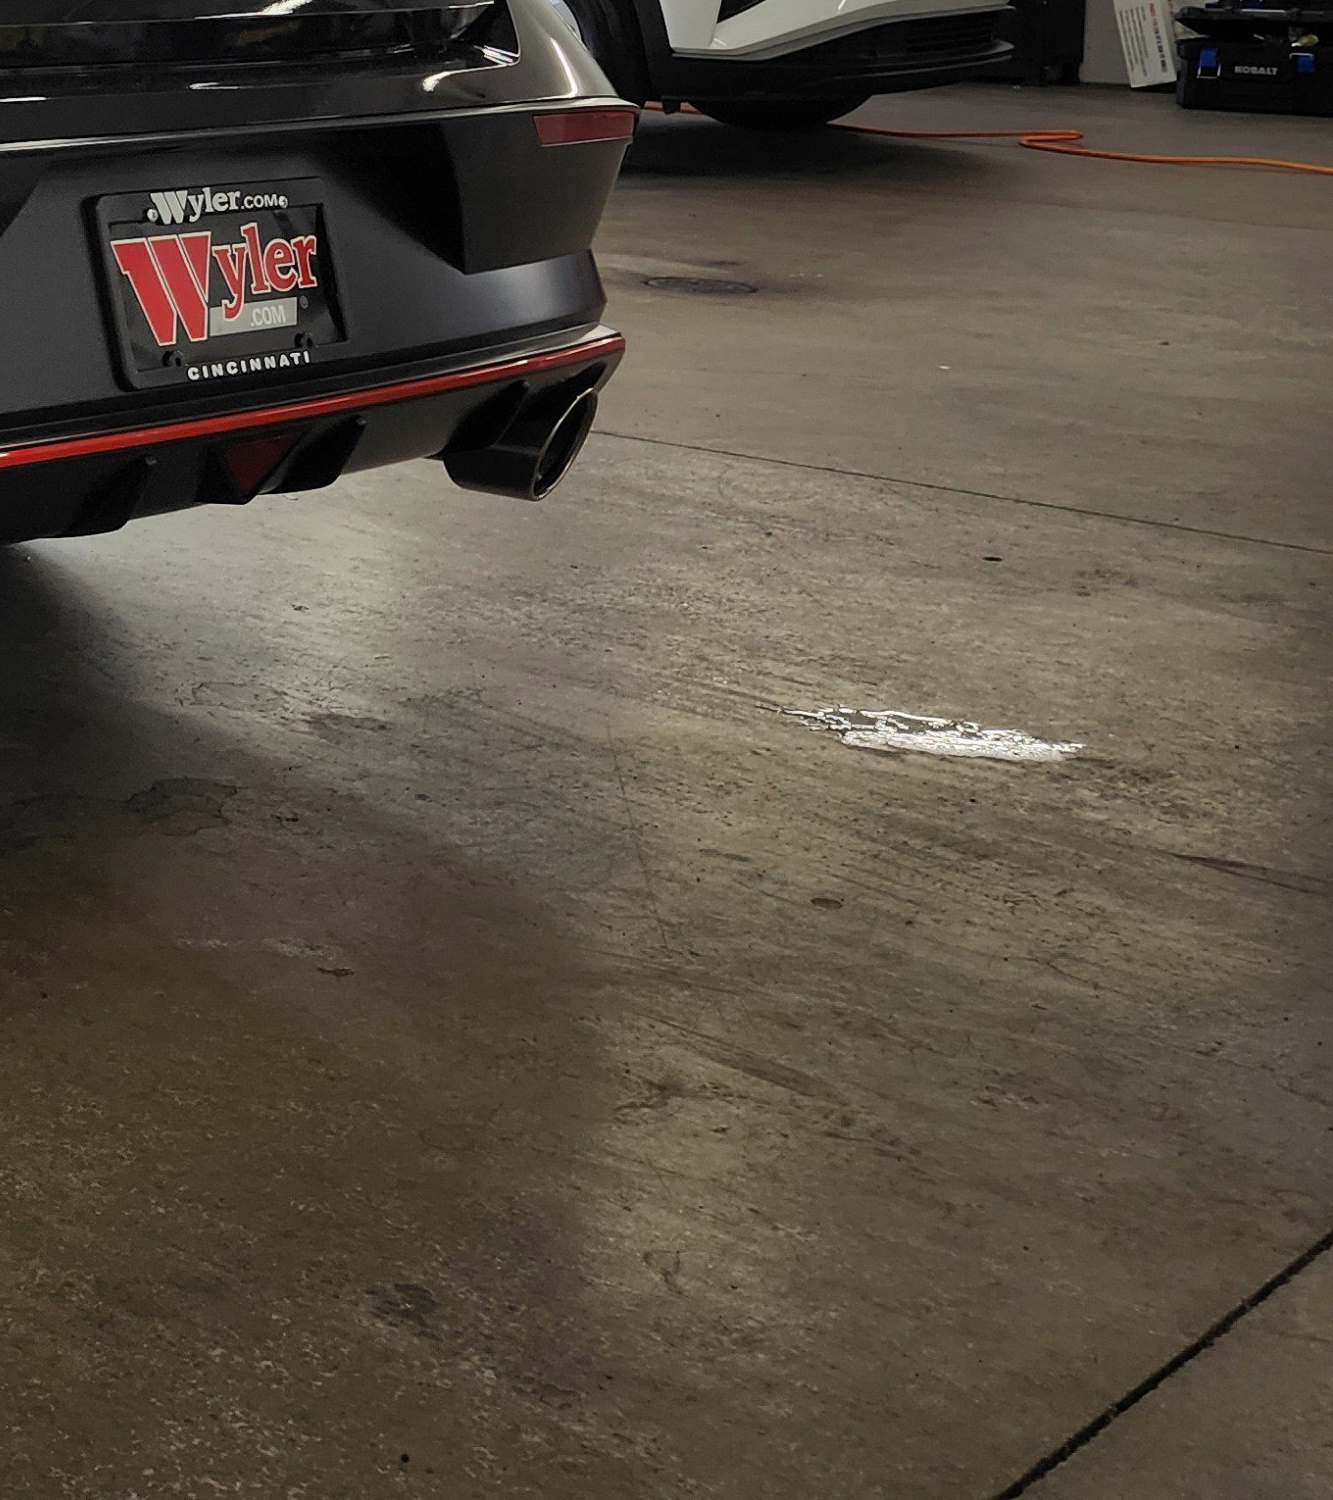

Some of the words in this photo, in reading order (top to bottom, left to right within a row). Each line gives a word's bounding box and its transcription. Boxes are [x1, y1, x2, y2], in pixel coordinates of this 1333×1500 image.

[1234, 66, 1278, 75] KOBALT
[110, 222, 319, 347] Wyler
[250, 304, 287, 327] .COM
[187, 350, 312, 381] CINCINNATI
